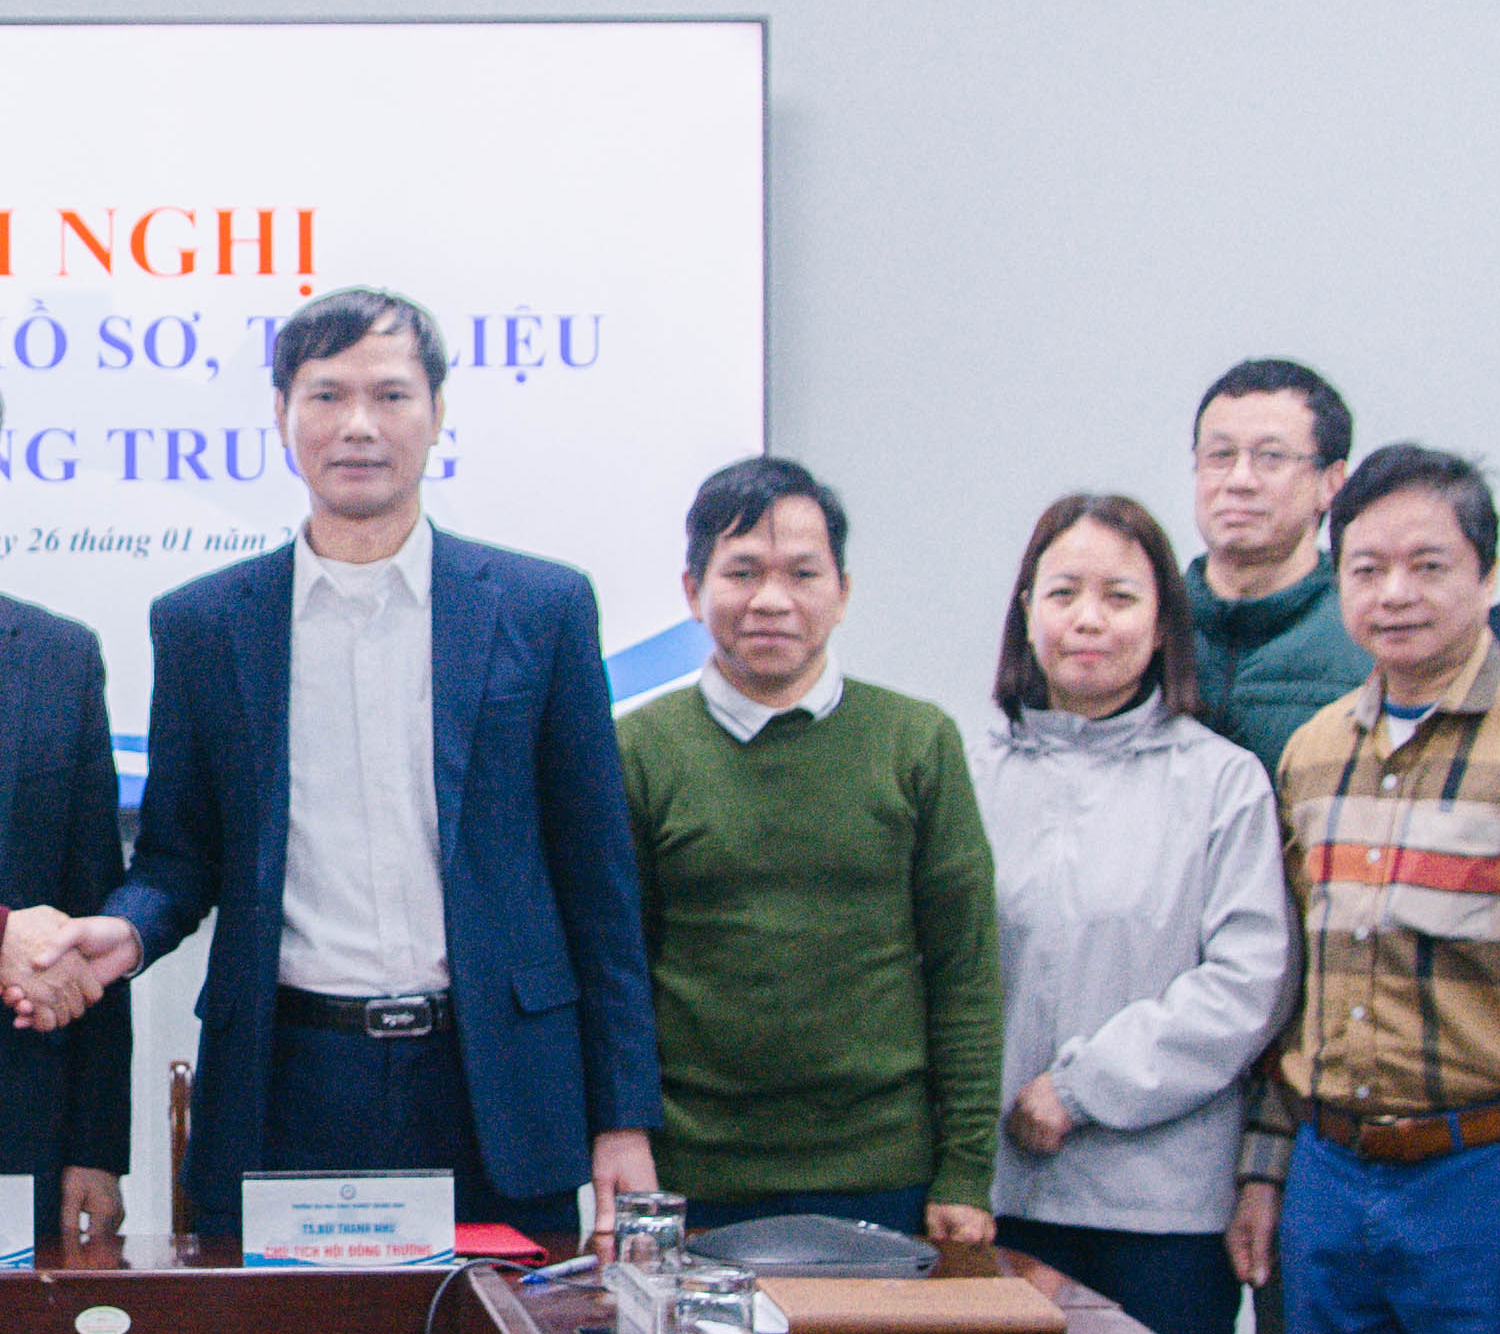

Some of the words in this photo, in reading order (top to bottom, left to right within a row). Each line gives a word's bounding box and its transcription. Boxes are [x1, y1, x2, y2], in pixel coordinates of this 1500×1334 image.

[56, 206, 319, 297] NGHỊ
[97, 311, 220, 382] SƠ,
[448, 305, 606, 384] IỆU
[26, 527, 61, 553] 26
[69, 525, 151, 559] tháng
[161, 526, 193, 552] 01
